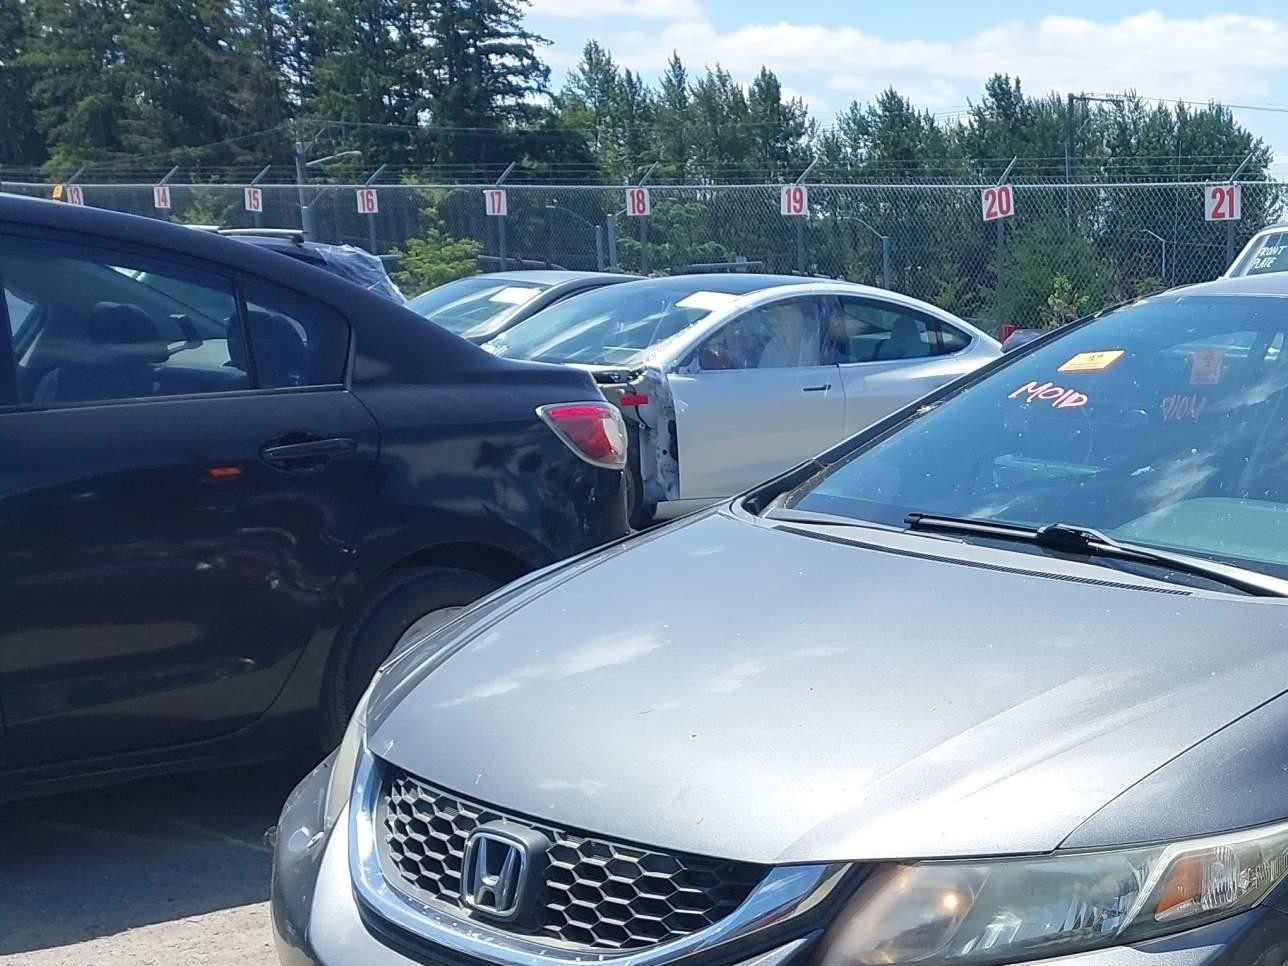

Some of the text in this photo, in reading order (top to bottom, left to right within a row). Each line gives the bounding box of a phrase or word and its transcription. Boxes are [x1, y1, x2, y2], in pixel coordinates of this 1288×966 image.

[157, 187, 167, 206] 14
[248, 189, 259, 210] 15
[360, 190, 374, 212] 16
[491, 191, 502, 214] 17
[630, 189, 645, 214] 18
[785, 187, 804, 213] 19
[985, 186, 1012, 219] 20
[1211, 187, 1235, 219] 21
